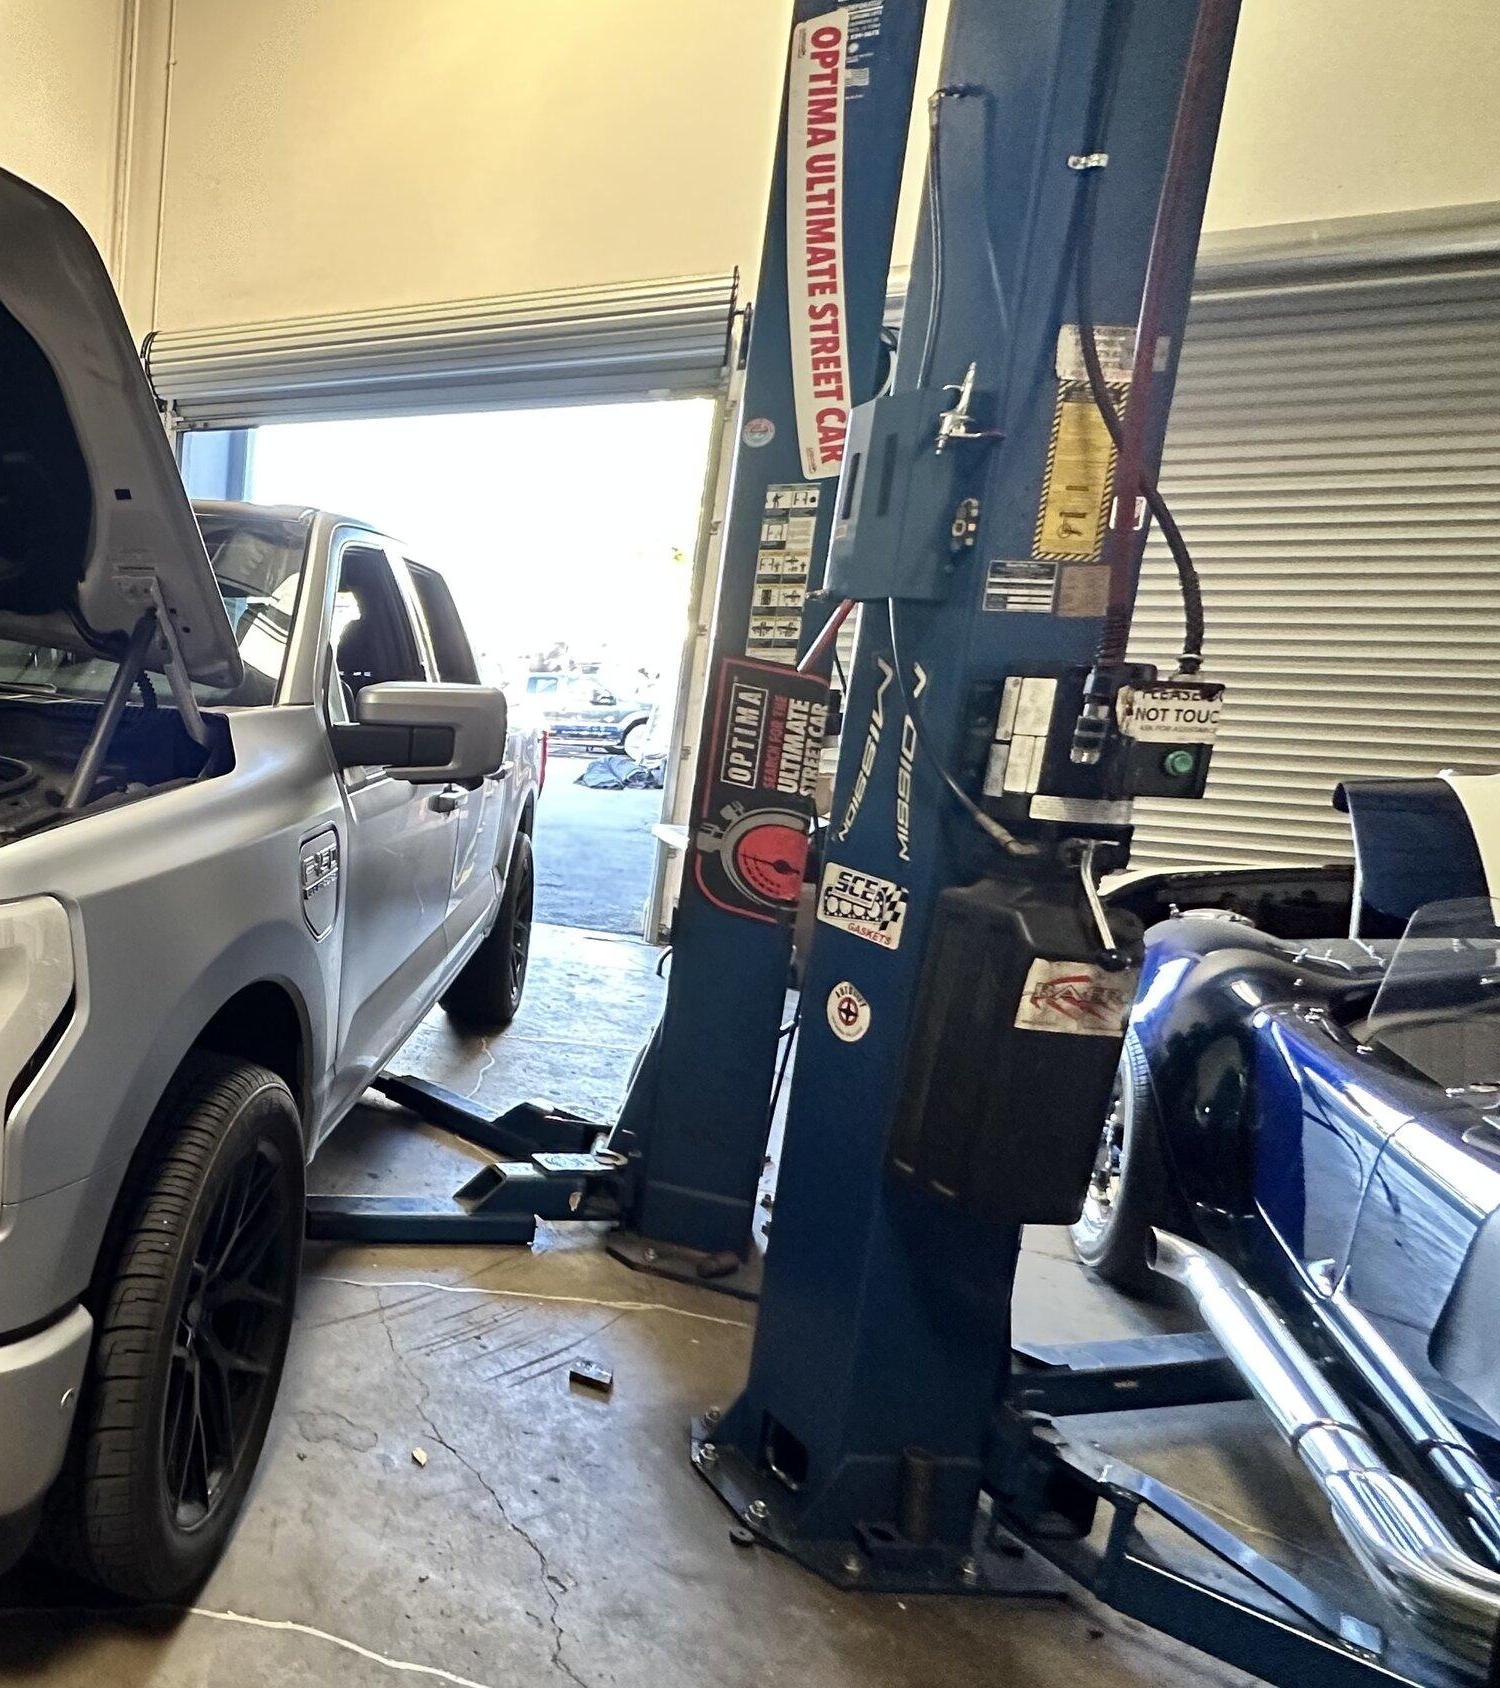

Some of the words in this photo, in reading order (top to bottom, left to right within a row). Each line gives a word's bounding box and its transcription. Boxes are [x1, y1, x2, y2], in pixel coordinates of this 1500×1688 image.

[806, 26, 843, 149] OPTIMA
[804, 153, 838, 298] ULTIMATE
[807, 302, 845, 401] STREET
[815, 407, 847, 464] CAR
[769, 720, 785, 744] FOR
[772, 694, 789, 719] THE
[807, 702, 829, 738] CAR
[1135, 707, 1170, 723] NOT
[727, 692, 763, 783] OPTIMA
[776, 697, 811, 794] ULTIMATE
[838, 656, 894, 843] MISSION
[799, 738, 822, 798] STREET
[835, 870, 879, 901] SCE
[846, 921, 892, 947] GASKETS
